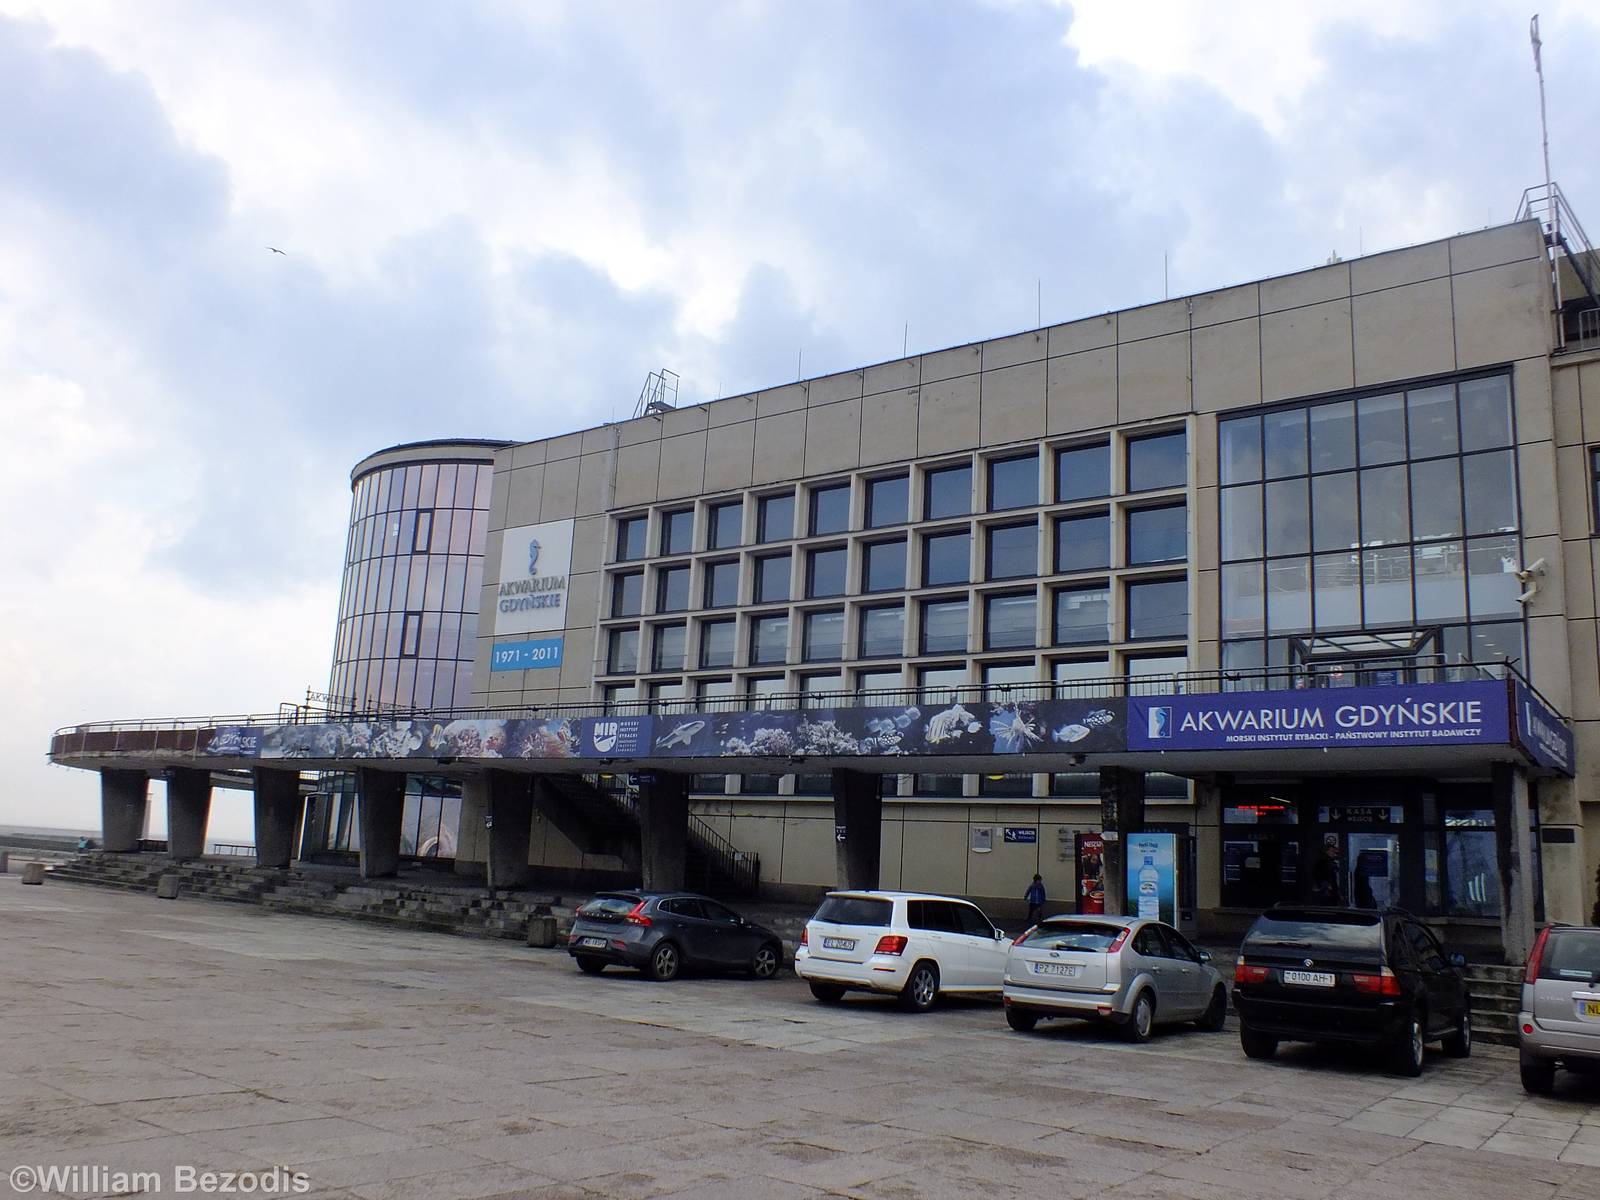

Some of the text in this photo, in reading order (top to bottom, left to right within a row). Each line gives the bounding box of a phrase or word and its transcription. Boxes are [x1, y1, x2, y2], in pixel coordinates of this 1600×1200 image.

[500, 576, 566, 597] AKWARIUM
[496, 650, 520, 663] 1971
[532, 647, 559, 660] 2011
[1180, 698, 1482, 731] AKWARIUM GDYŃSKIE
[594, 722, 618, 736] MIR
[1258, 734, 1293, 742] INSTYTUT
[1335, 730, 1387, 739] PAŃSTWOWY
[1390, 729, 1430, 738] INSTYTUT
[1432, 729, 1482, 737] BADAWCZY
